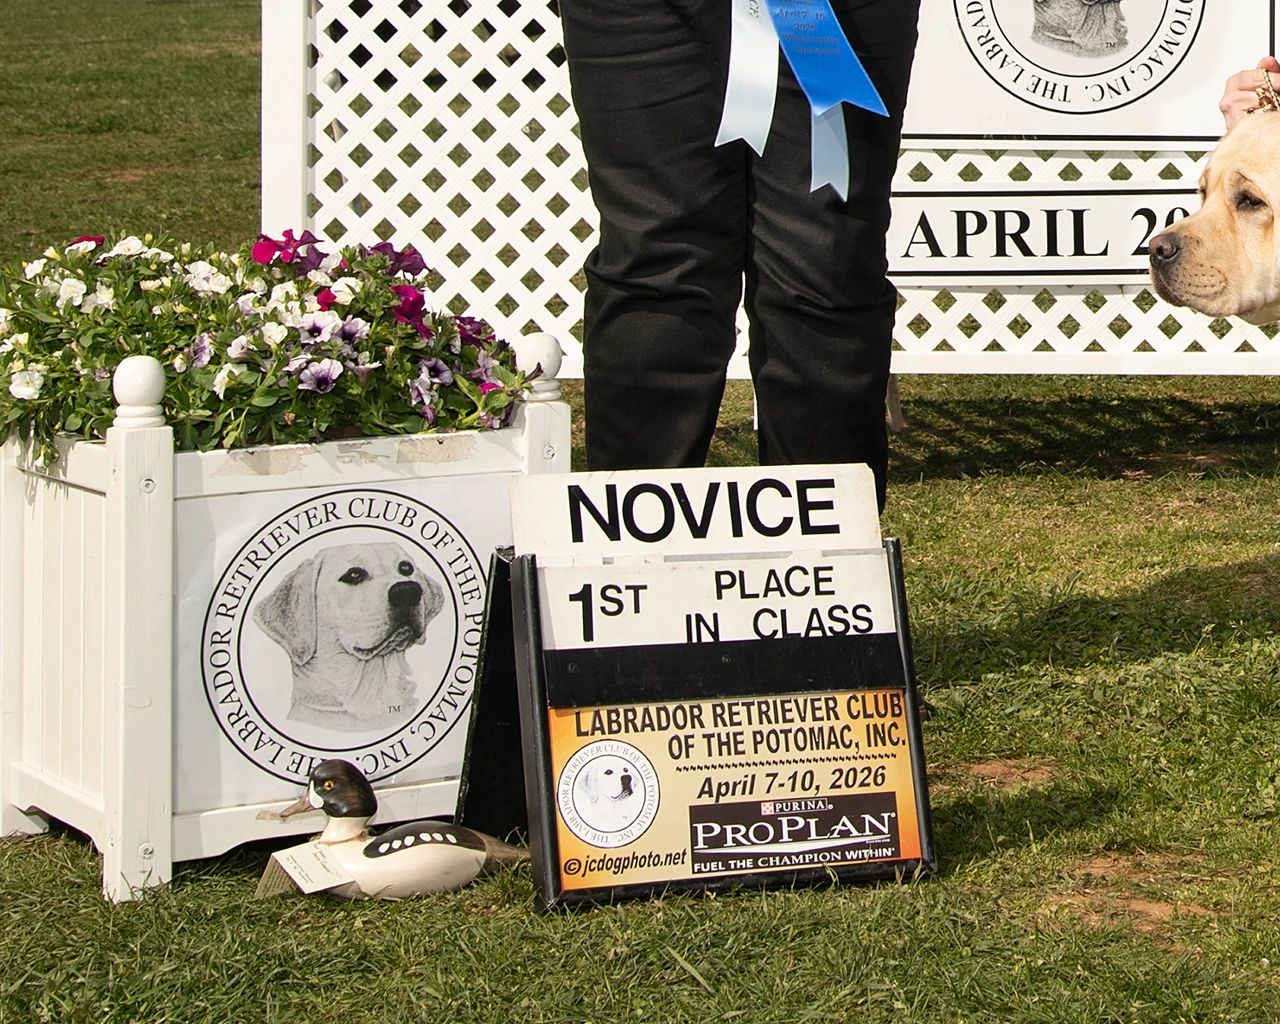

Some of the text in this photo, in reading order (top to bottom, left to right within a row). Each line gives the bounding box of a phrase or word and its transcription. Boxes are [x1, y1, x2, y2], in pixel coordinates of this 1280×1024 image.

[1026, 75, 1071, 103] THE
[1084, 75, 1131, 103] INC.
[900, 208, 1109, 258] APRIL
[348, 497, 418, 528] CLUB
[567, 478, 840, 543] NOVICE
[419, 520, 455, 551] OF
[214, 500, 342, 622] RETRIEVER
[455, 547, 482, 606] THE
[568, 565, 835, 642] 1ST PLACE
[685, 603, 874, 643] IN CLASS
[210, 628, 287, 765] LABRADOR
[575, 692, 904, 737] LABRADOR RETRIEVER CLUB
[355, 741, 412, 776] INC.
[668, 721, 906, 760] OF THE POTOMAC, INC.
[697, 764, 886, 803] April 7-10, 2026
[775, 800, 826, 813] PURINA
[582, 849, 688, 877] jcdogphoto.net
[694, 862, 726, 873] FUEL
[728, 859, 754, 869] THE
[757, 851, 842, 867] CHAMPION
